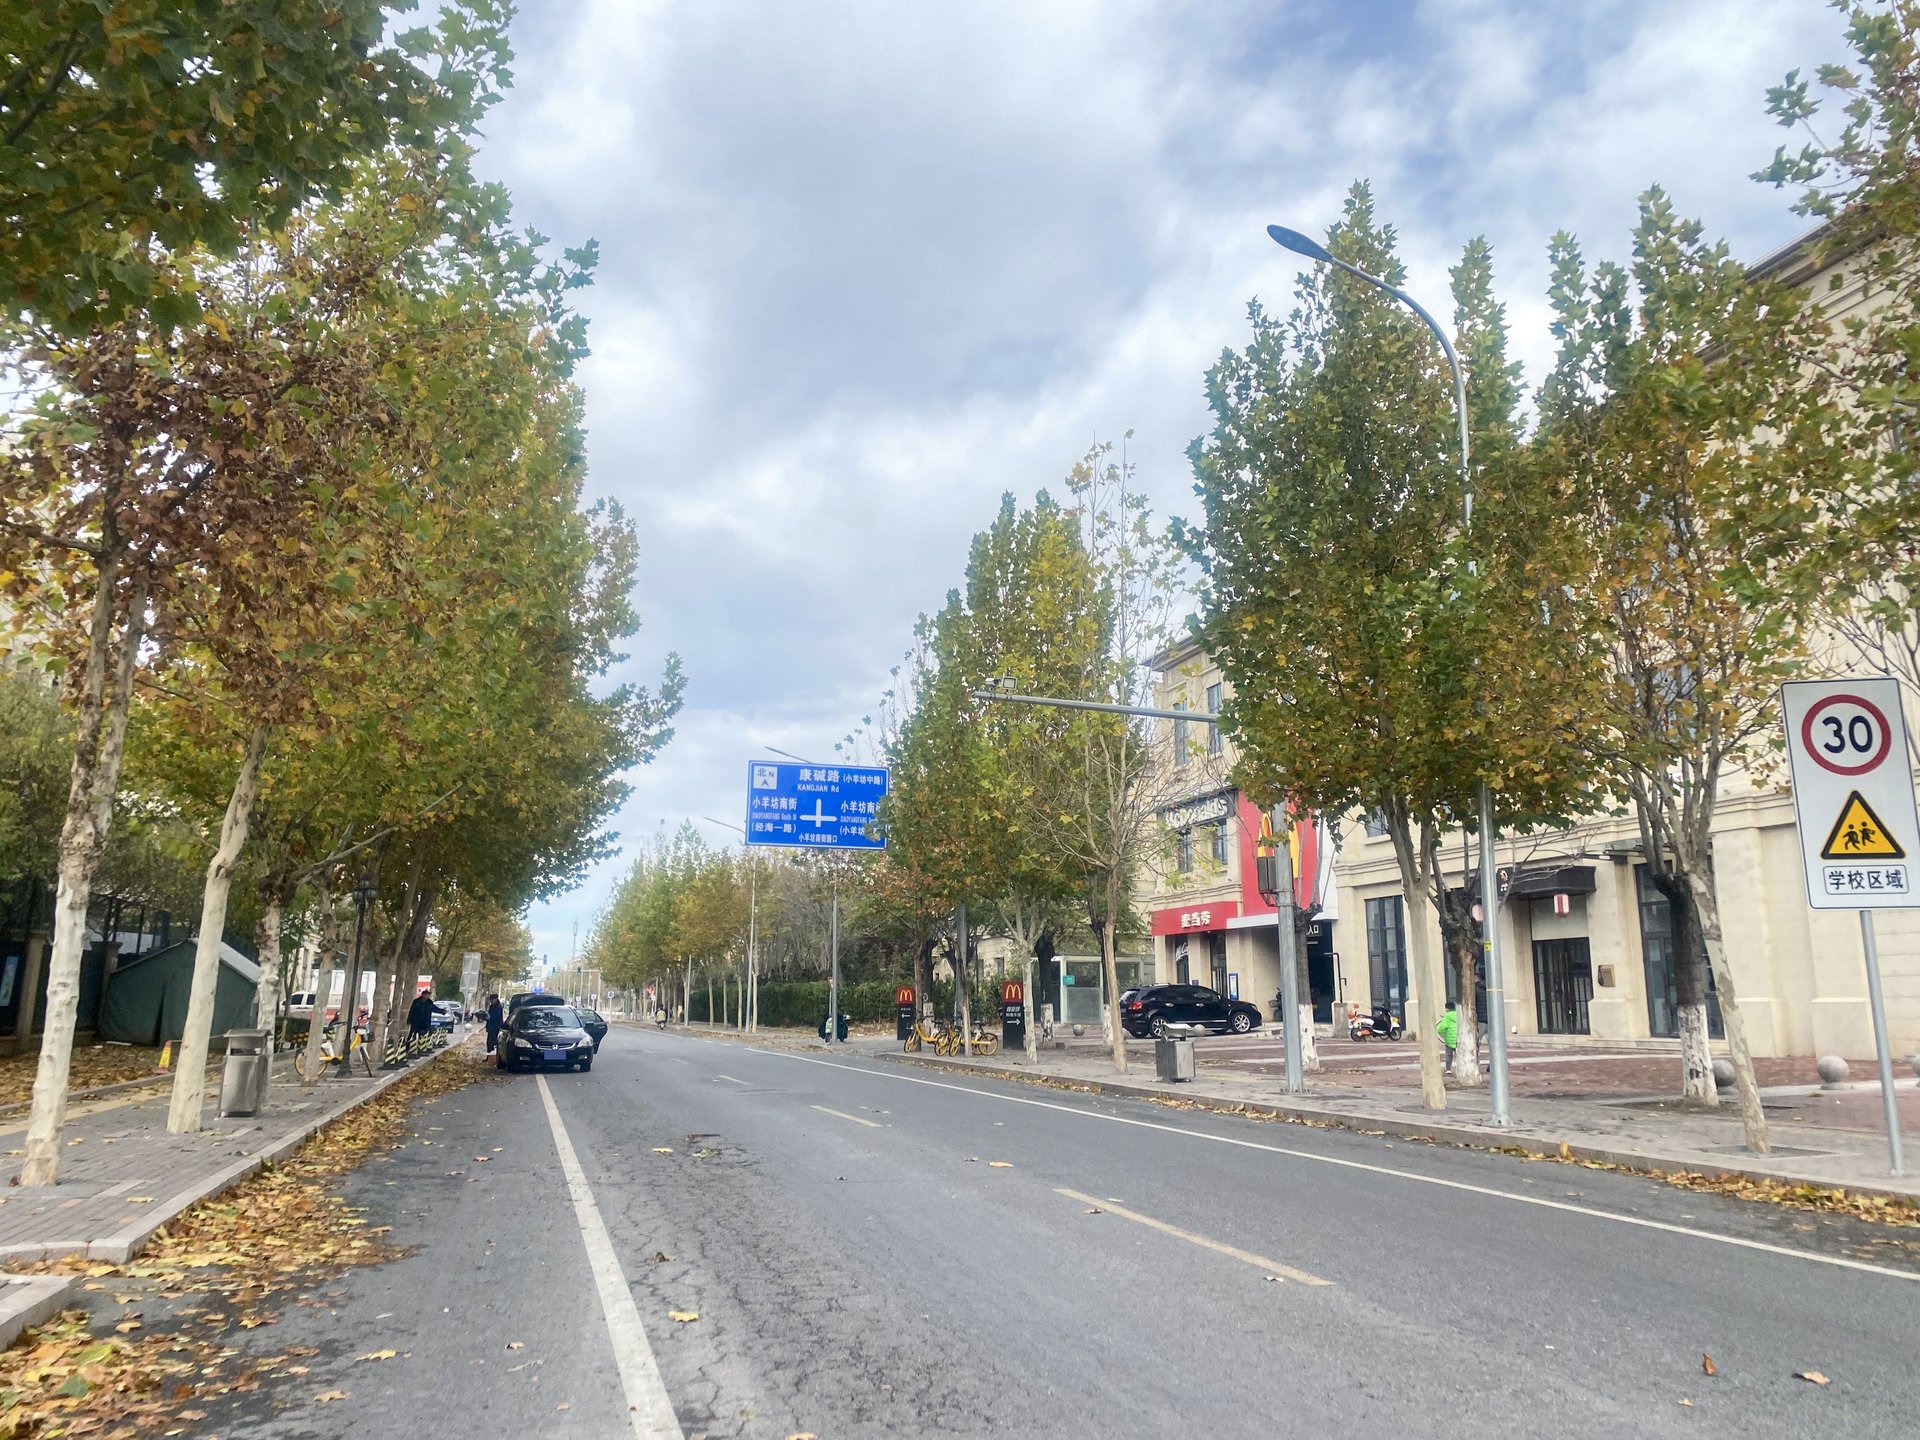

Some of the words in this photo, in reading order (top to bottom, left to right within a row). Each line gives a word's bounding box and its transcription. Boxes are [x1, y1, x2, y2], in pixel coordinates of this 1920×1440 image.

[1821, 715, 1873, 754] 30
[757, 768, 766, 777] 北
[797, 784, 828, 793] KANGJIAN
[831, 785, 840, 793] Rd
[752, 796, 797, 810] 小羊坊南街
[1828, 869, 1903, 890] 学校区域
[1181, 911, 1211, 928] 麦当劳
